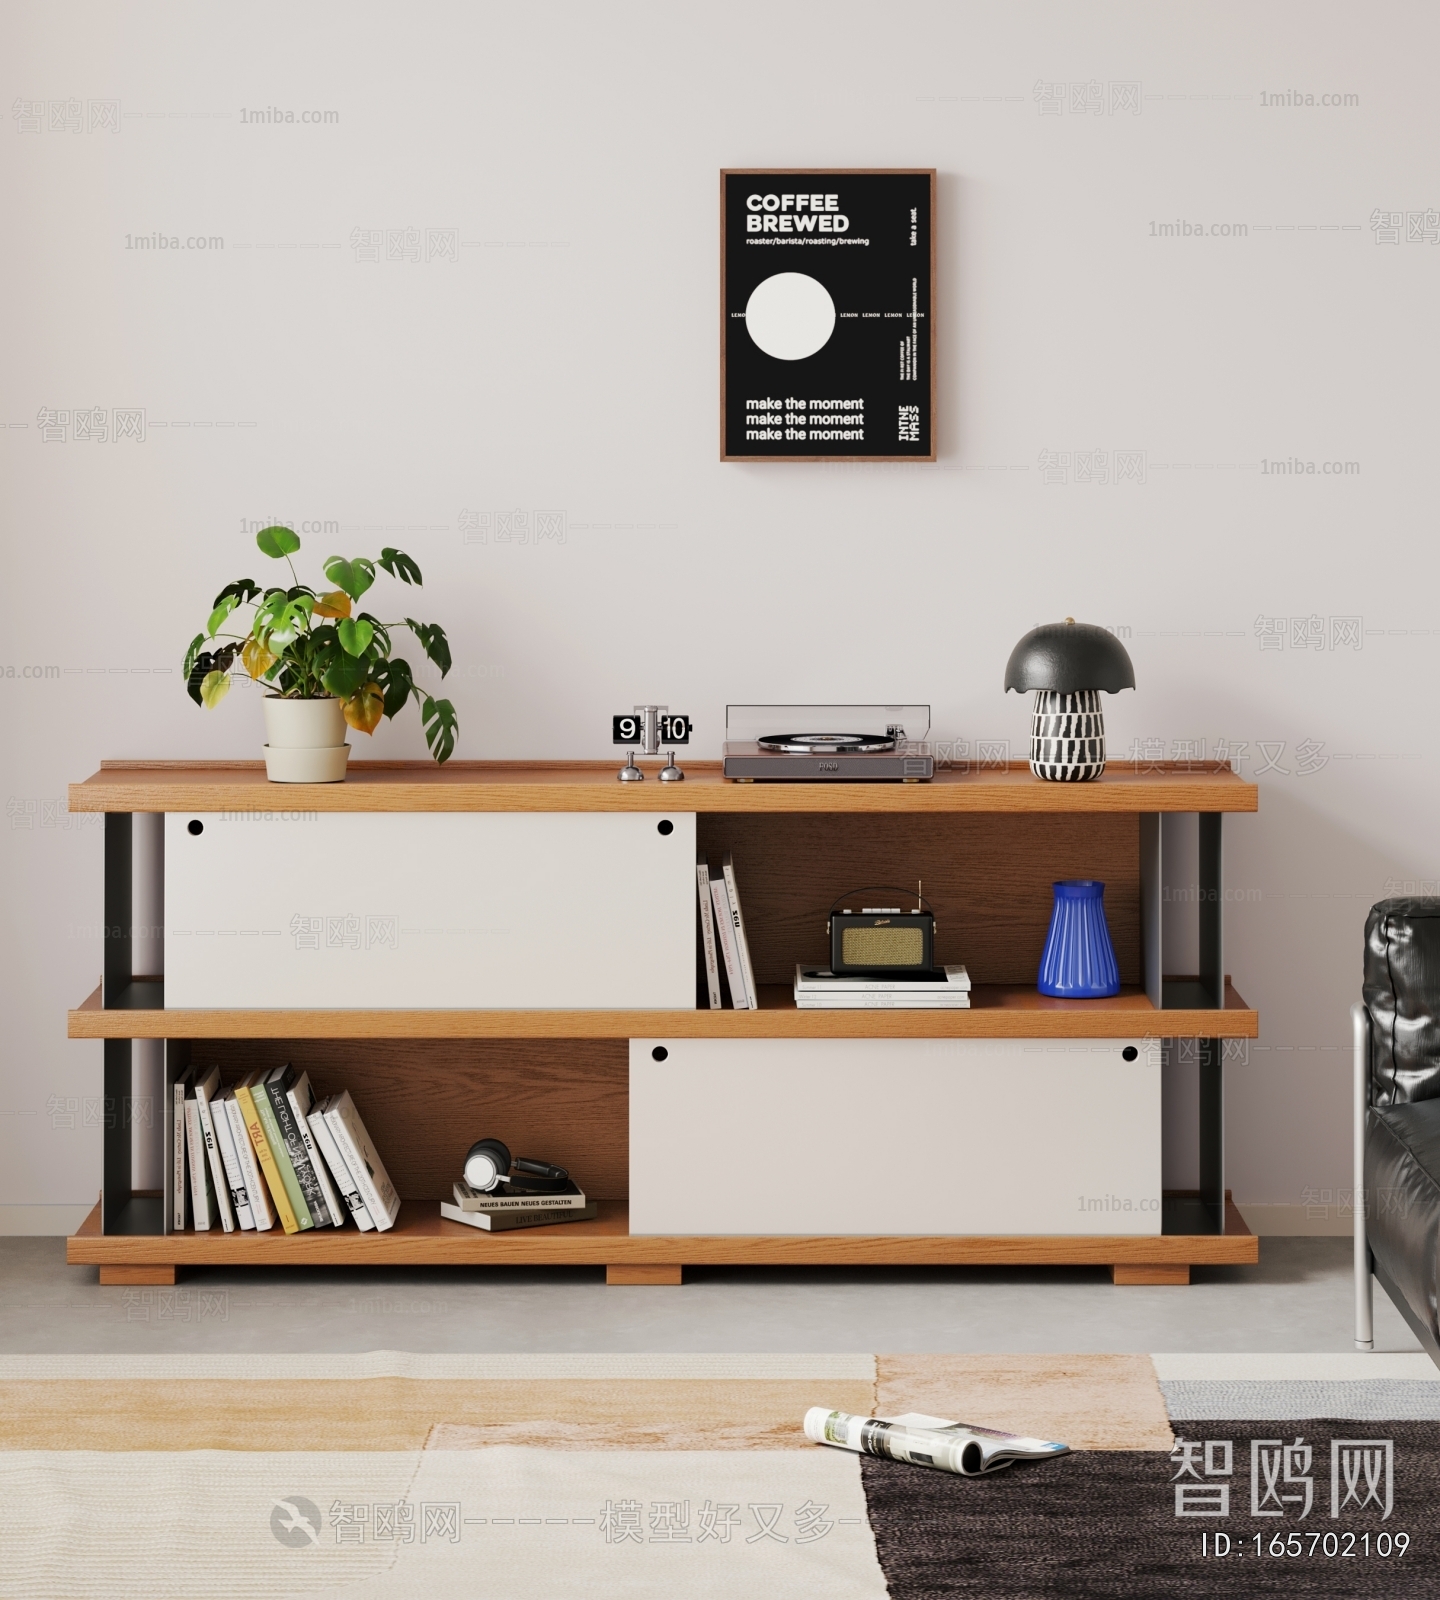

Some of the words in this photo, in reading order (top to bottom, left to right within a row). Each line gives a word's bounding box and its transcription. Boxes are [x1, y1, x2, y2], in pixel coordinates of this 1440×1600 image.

[746, 194, 839, 212] COFFEE
[746, 214, 850, 232] BREWED
[746, 238, 870, 246] roaster/barista/roasting/brewing
[909, 231, 917, 246] take
[746, 397, 782, 410] make
[785, 397, 806, 410] the
[809, 398, 864, 410] moment
[746, 412, 782, 425] make
[785, 412, 806, 425] the
[809, 413, 864, 425] moment
[909, 405, 920, 441] MASS
[746, 427, 782, 440] make
[785, 427, 806, 440] the
[809, 428, 864, 440] moment
[619, 718, 636, 739] 9
[664, 717, 686, 740] 10
[515, 1214, 532, 1224] LIVE
[533, 1210, 573, 1222] BEAUTIFUL
